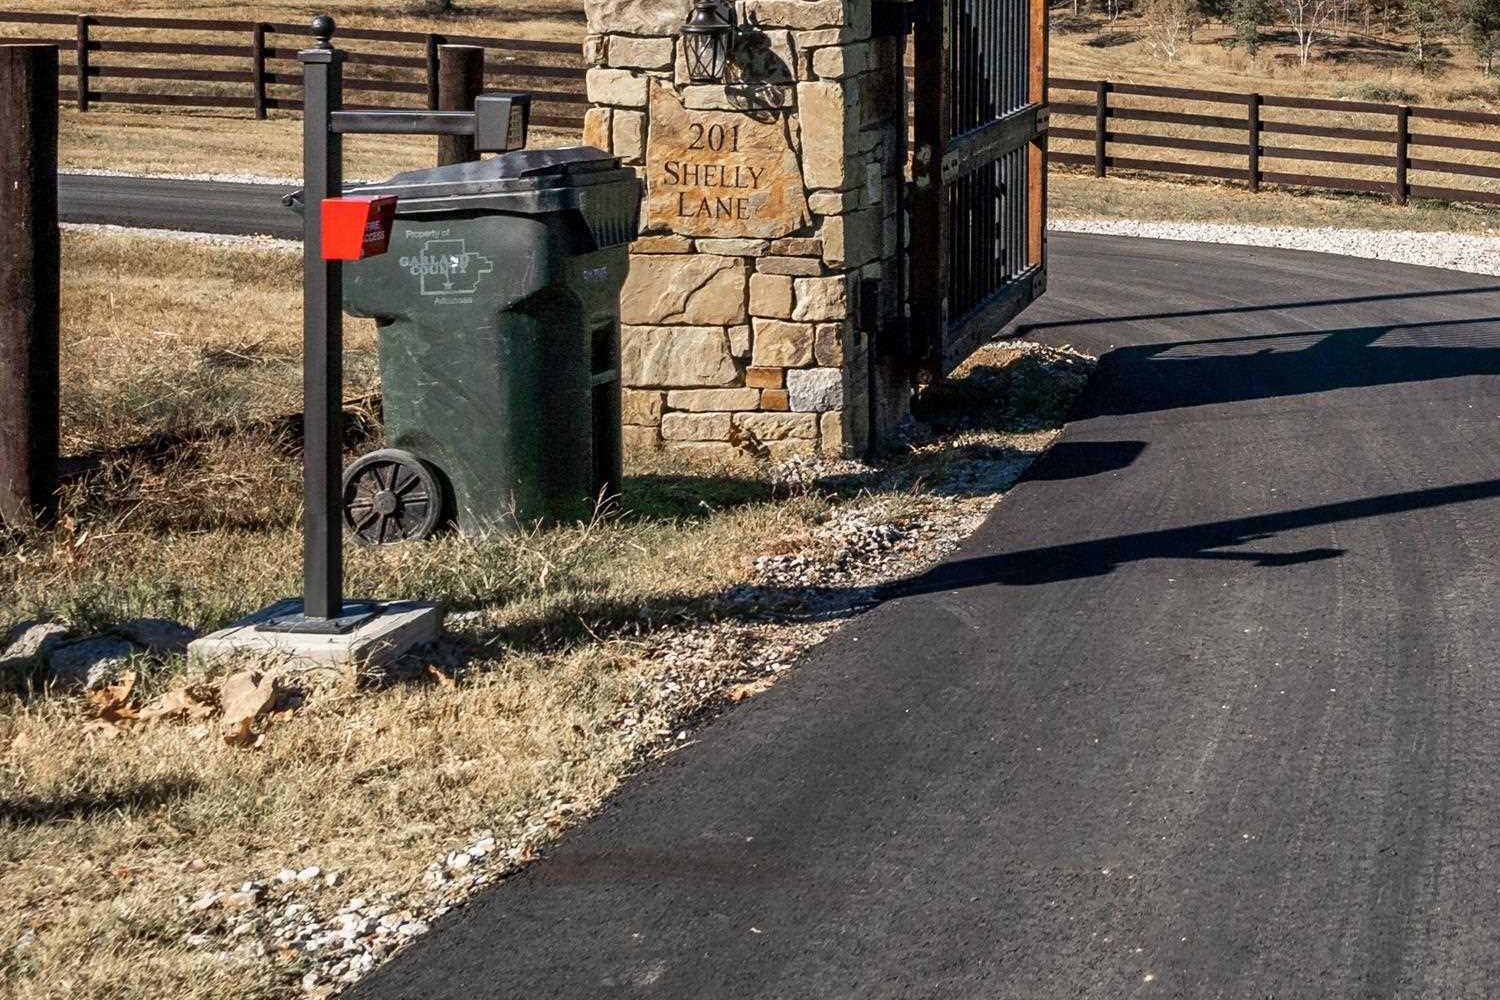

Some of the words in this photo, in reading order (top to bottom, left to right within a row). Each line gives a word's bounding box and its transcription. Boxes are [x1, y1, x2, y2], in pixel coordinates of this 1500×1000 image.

[687, 122, 740, 153] 201
[663, 160, 766, 190] SHELLY
[677, 190, 751, 221] LANE
